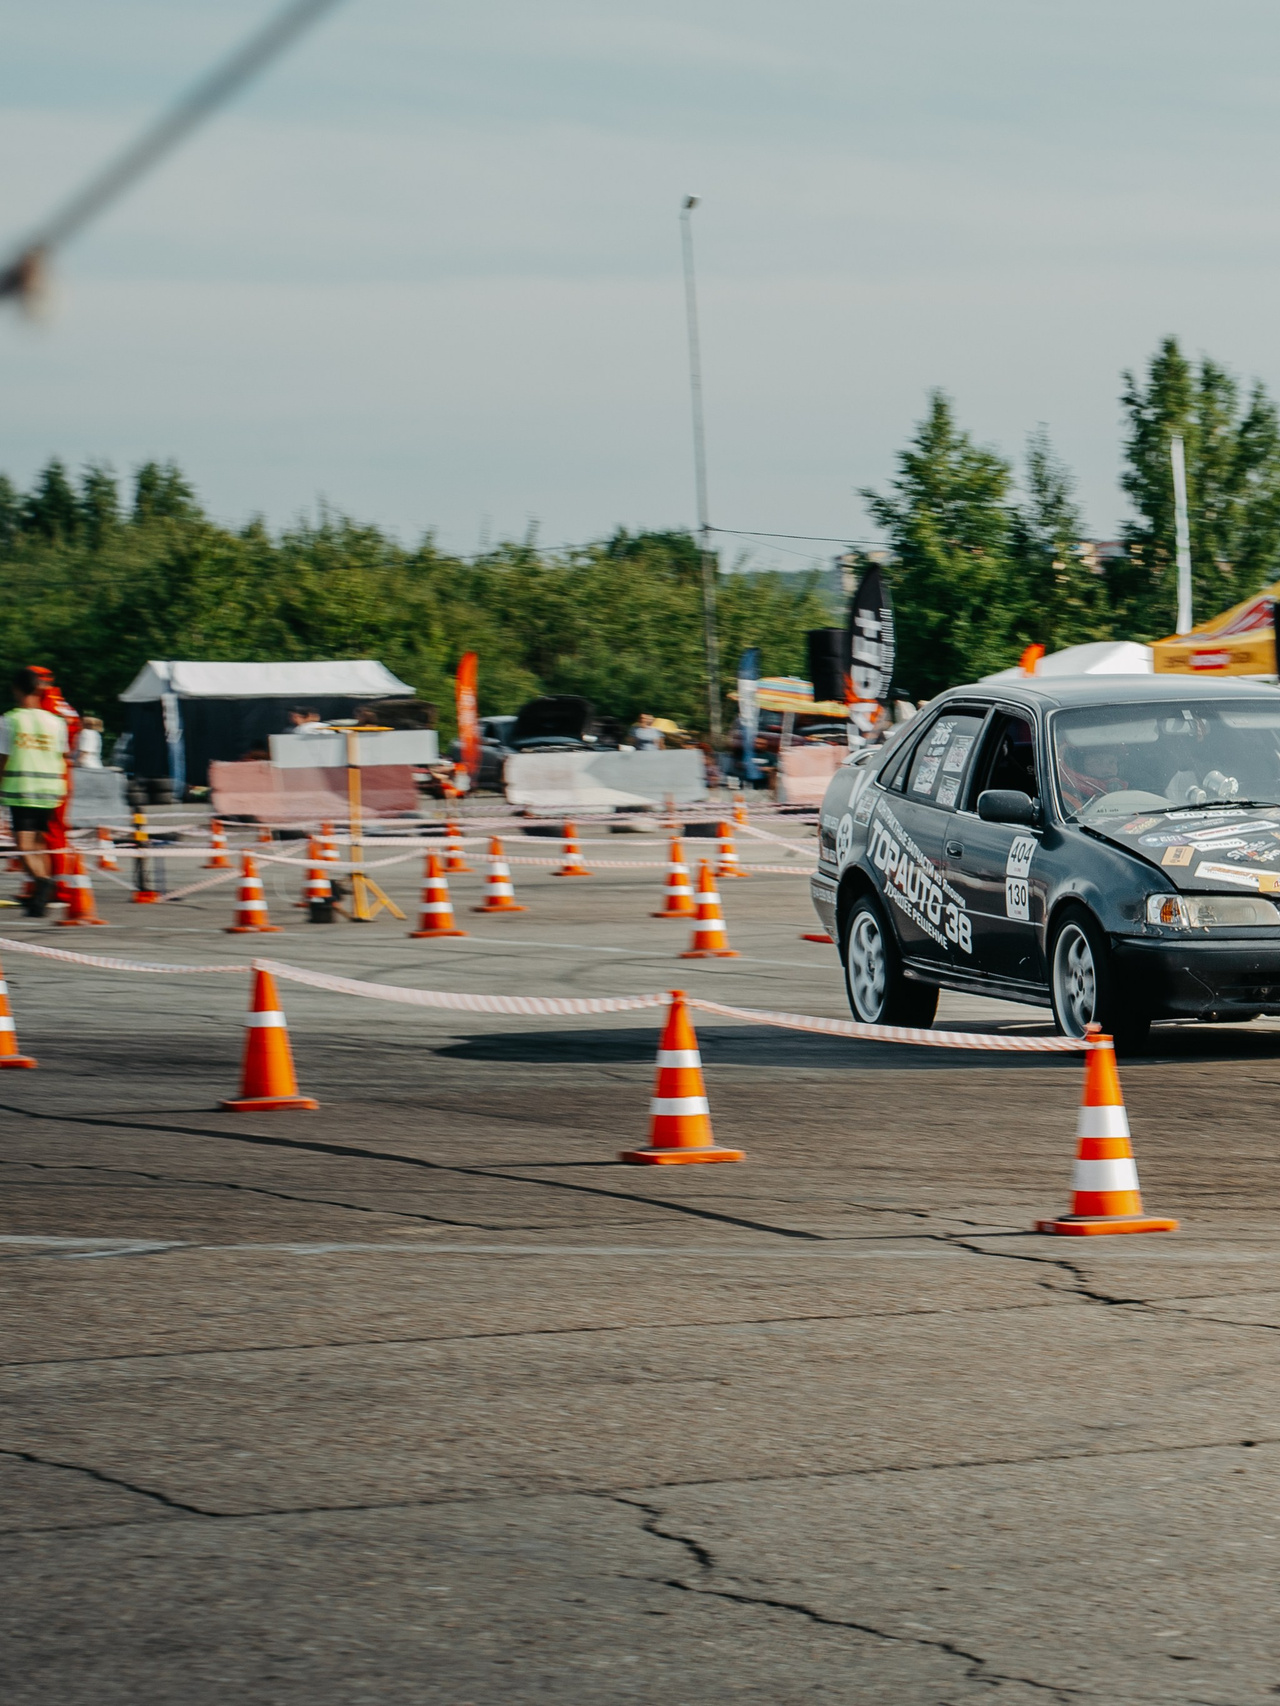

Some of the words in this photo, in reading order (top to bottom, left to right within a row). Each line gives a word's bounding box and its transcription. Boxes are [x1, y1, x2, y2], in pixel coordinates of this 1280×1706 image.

[1010, 841, 1034, 865] 404
[866, 818, 944, 926] TOPAUTO
[945, 902, 973, 955] 38
[1008, 883, 1027, 907] 130
[912, 907, 948, 950] РЕШЕНИЕ
